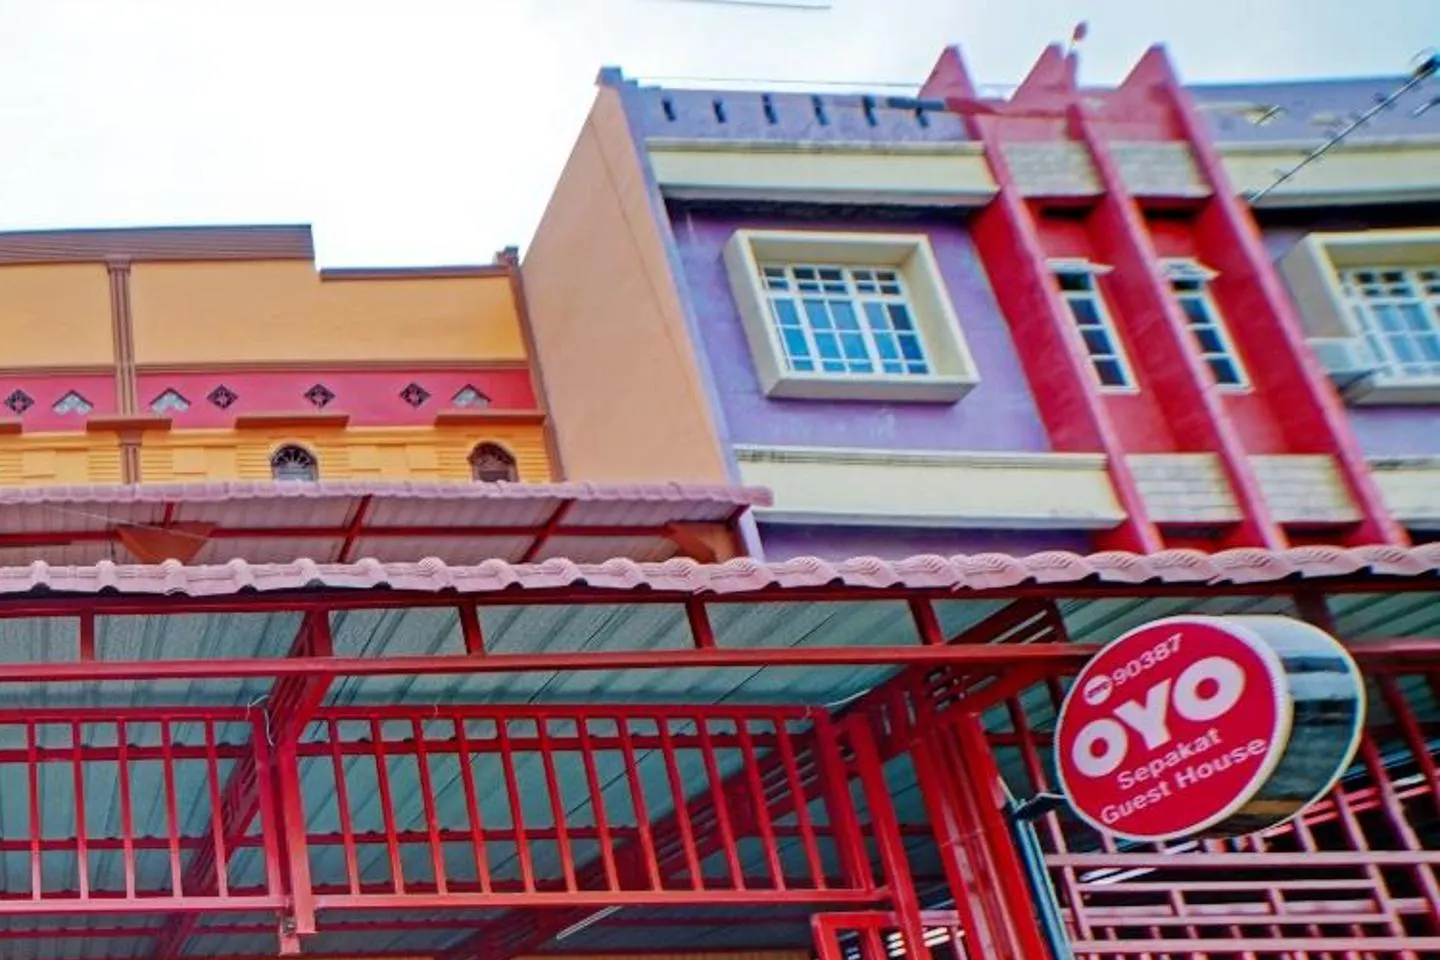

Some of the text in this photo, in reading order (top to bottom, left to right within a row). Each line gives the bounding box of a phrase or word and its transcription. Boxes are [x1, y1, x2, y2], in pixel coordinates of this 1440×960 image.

[1112, 632, 1183, 687] 90387
[1072, 656, 1247, 778] OYO
[1100, 738, 1267, 825] Guest House
[1117, 727, 1223, 790] Sepakat
